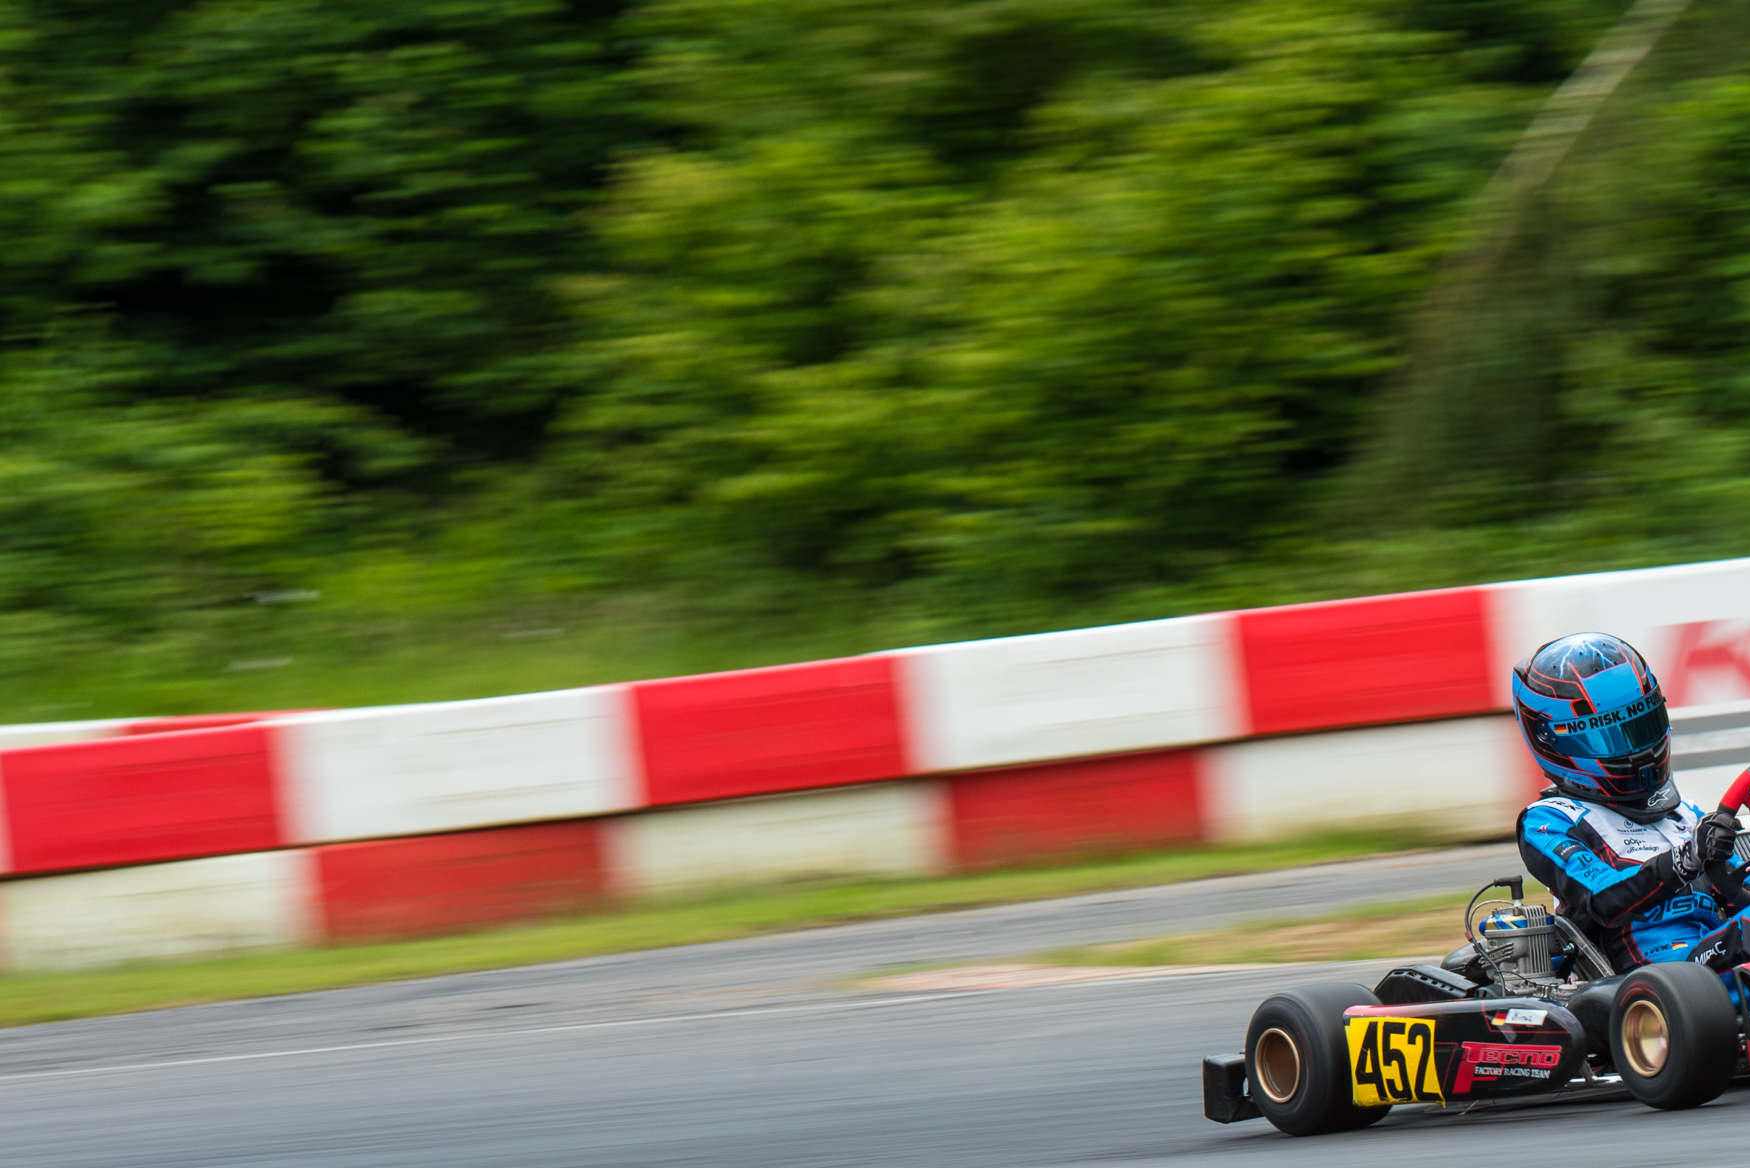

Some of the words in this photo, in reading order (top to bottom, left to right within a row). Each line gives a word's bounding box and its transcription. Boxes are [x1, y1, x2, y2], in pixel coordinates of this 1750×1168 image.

[1567, 720, 1587, 734] NO
[1588, 711, 1626, 730] RISK.
[1626, 702, 1645, 718] NO
[1355, 1021, 1445, 1101] 452
[1474, 1066, 1503, 1076] FACTORY
[1503, 1068, 1530, 1078] RACING
[1530, 1069, 1551, 1079] TEAM
